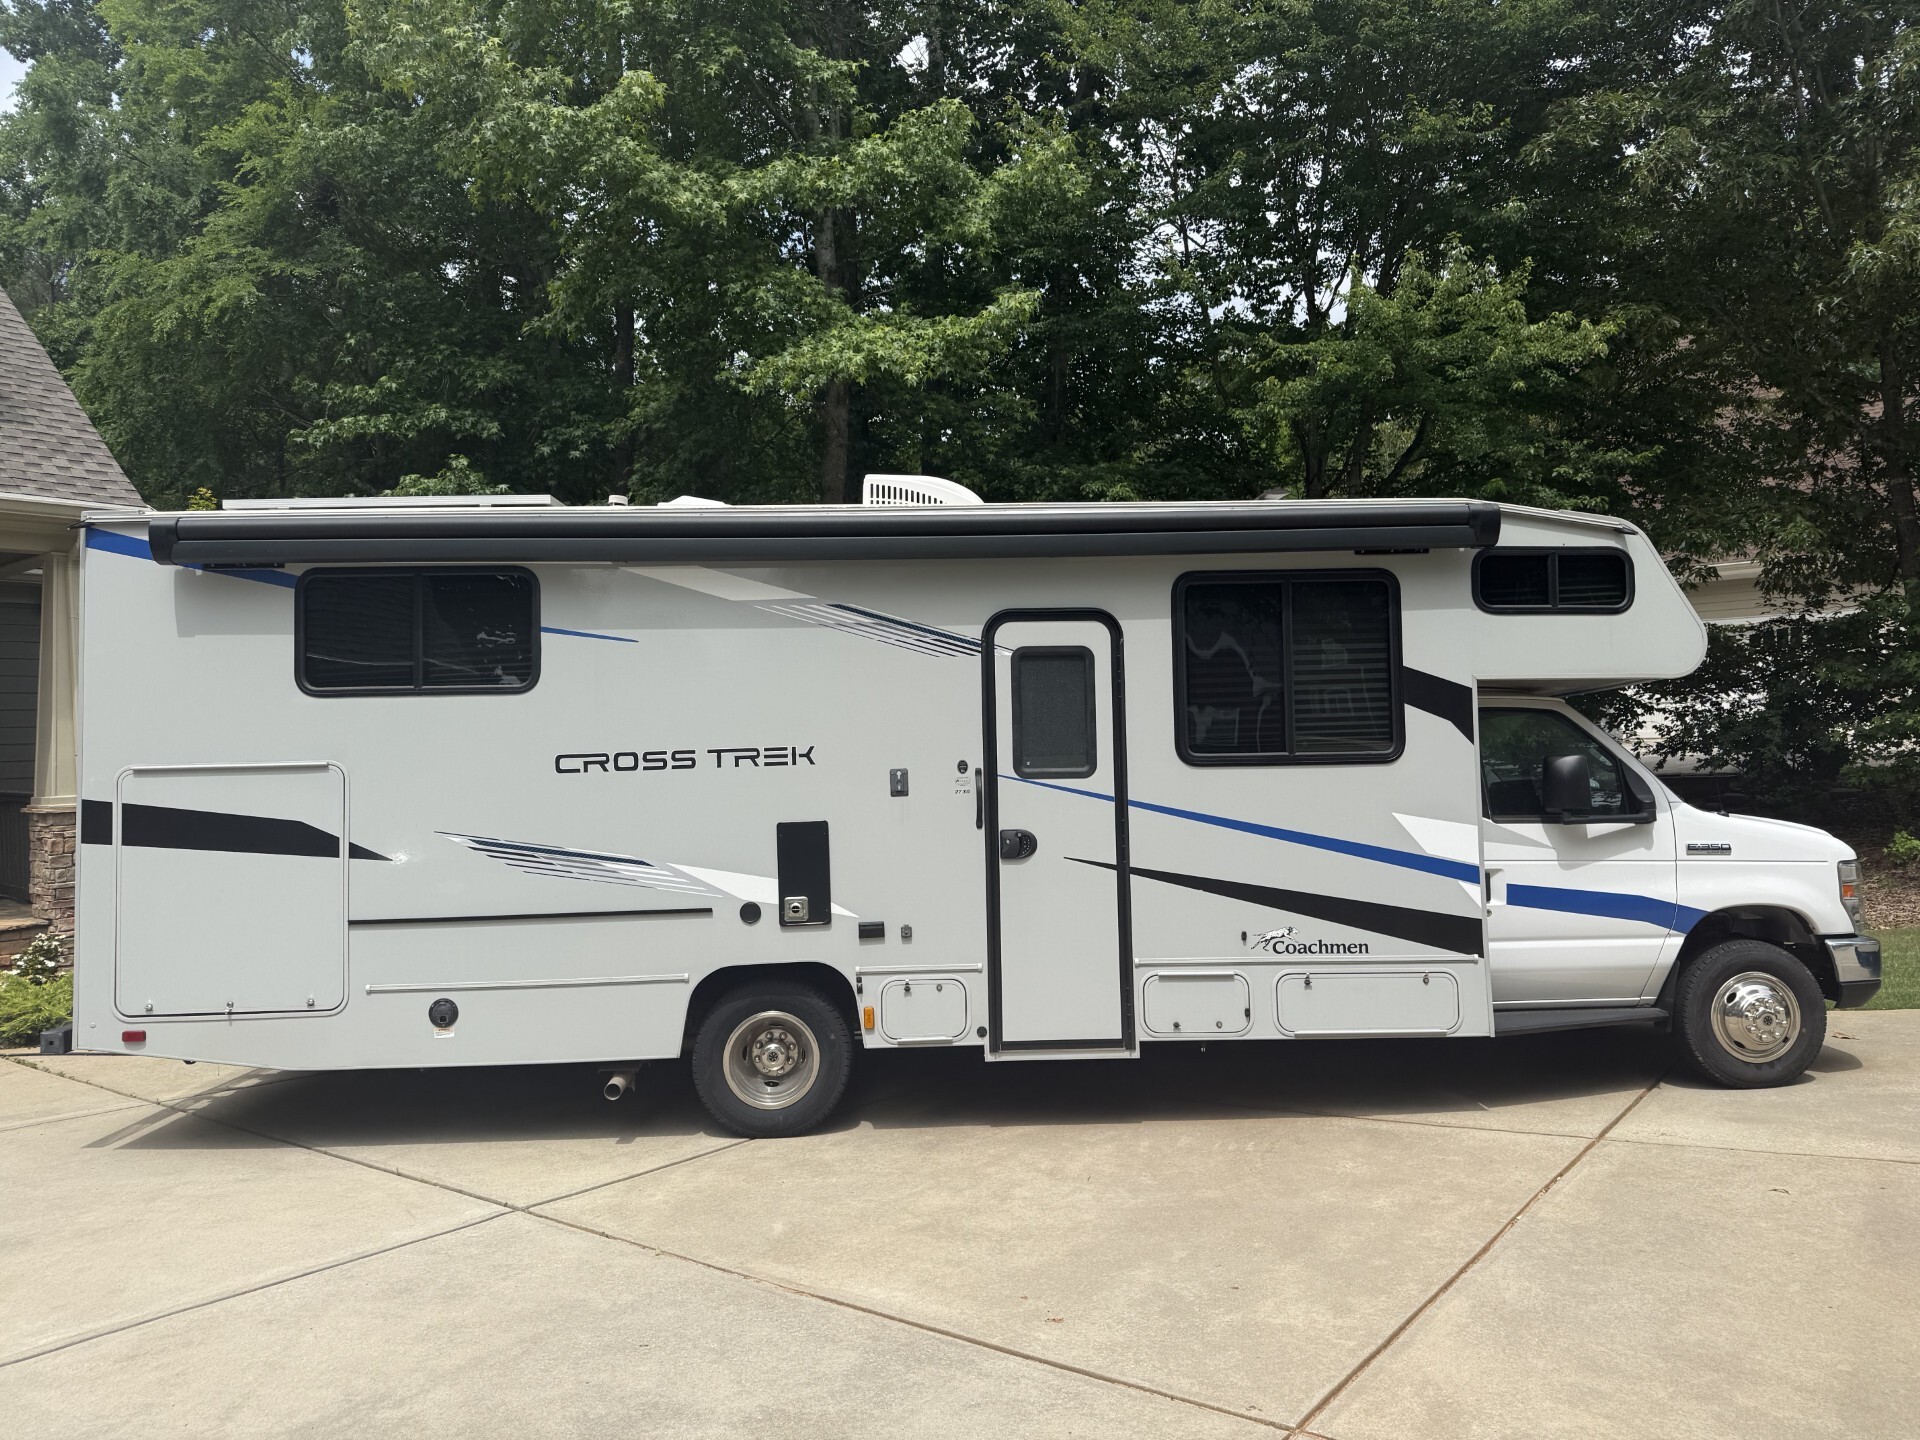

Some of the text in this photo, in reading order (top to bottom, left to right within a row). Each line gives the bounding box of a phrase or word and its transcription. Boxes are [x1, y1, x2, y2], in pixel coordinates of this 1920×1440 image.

[554, 745, 816, 774] CROSS TREK
[1272, 939, 1369, 955] Coachmen
